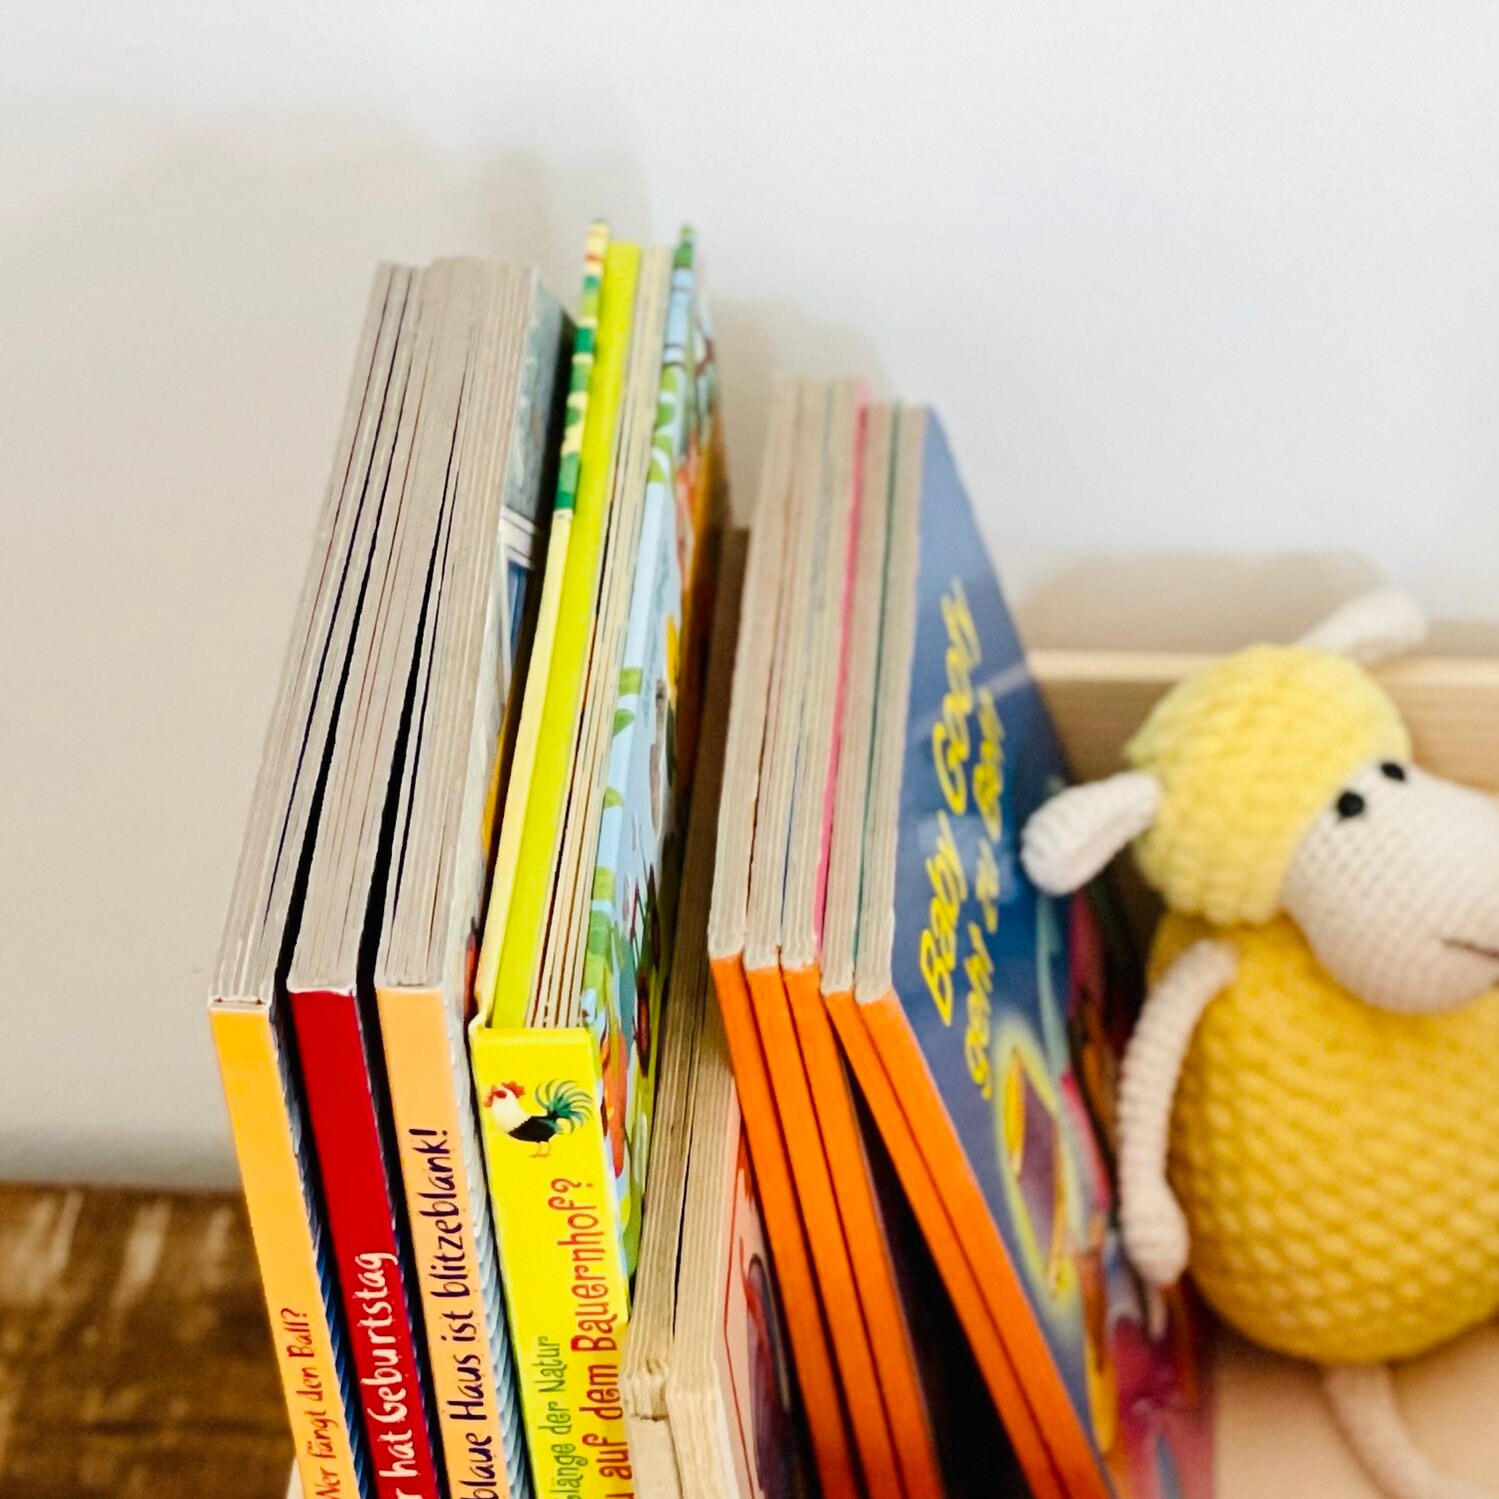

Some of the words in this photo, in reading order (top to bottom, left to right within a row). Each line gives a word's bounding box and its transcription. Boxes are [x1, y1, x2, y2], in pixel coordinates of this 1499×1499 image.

[409, 1127, 470, 1298] blitzeblank!
[547, 1177, 618, 1352] Bauernhof?
[280, 1307, 315, 1357] Ball?
[353, 1252, 407, 1423] Geburtstag
[441, 1309, 477, 1343] ist
[296, 1367, 323, 1401] den
[448, 1354, 488, 1421] Haus
[537, 1335, 567, 1394] Natur
[579, 1364, 623, 1421] dem
[307, 1409, 339, 1459] fängt
[540, 1400, 571, 1437] der
[378, 1429, 418, 1477] hat
[581, 1433, 634, 1483] auf
